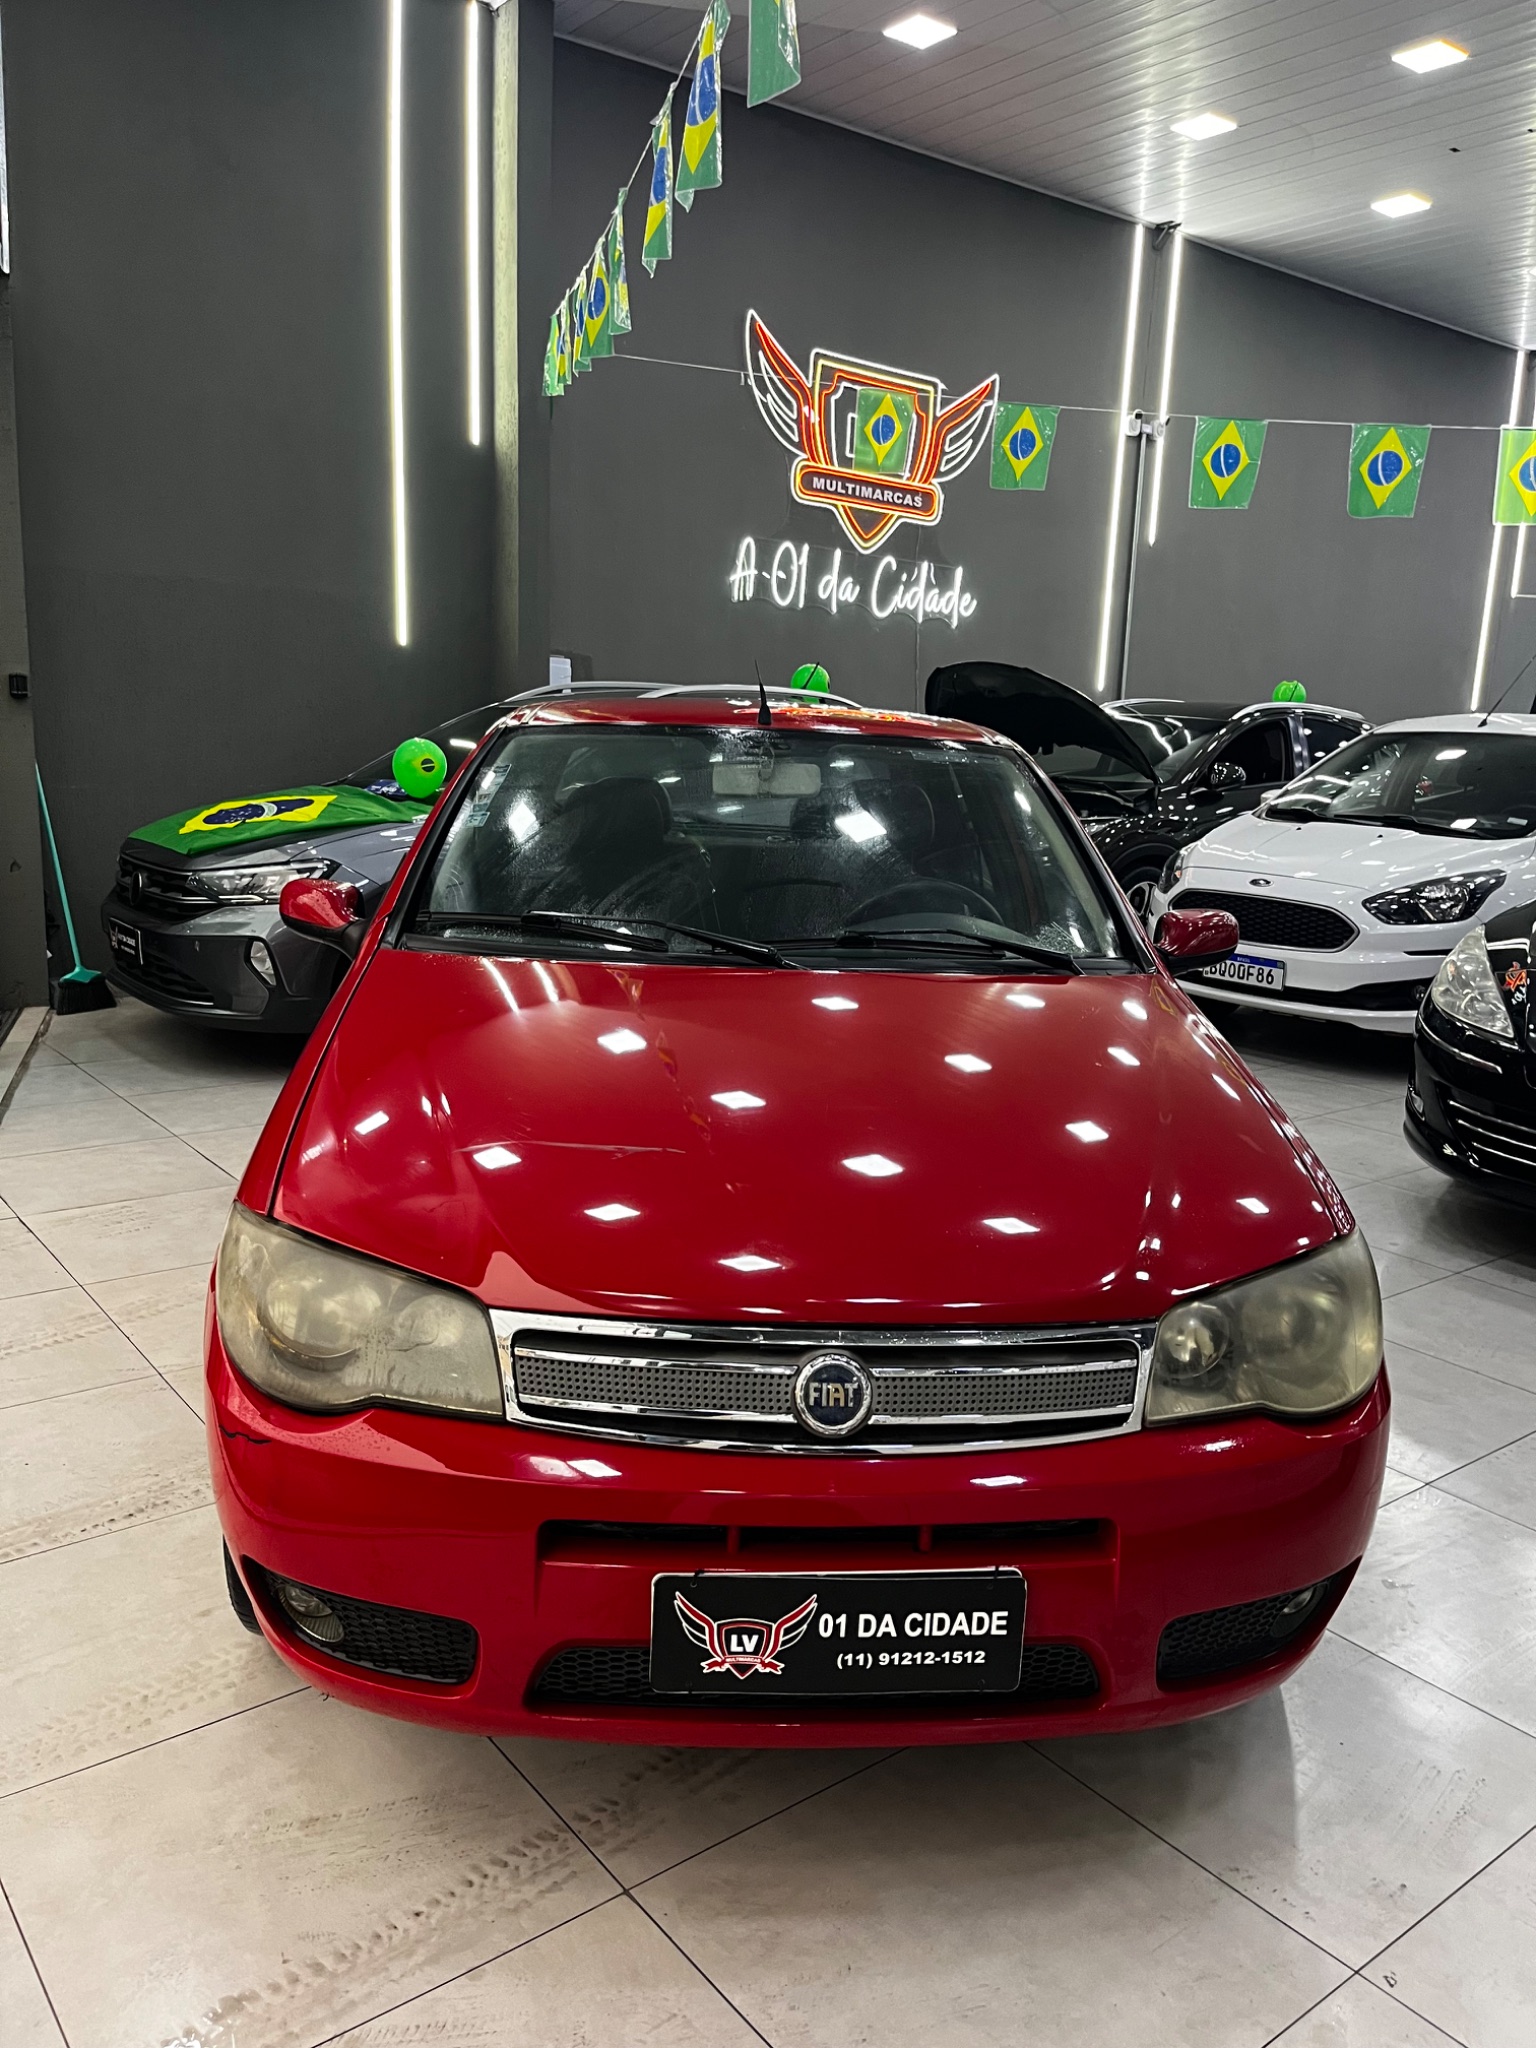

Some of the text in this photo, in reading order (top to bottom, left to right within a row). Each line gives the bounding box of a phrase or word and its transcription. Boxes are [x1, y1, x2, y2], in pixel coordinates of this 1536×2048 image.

[812, 477, 923, 507] MULTIMARCAS
[818, 548, 860, 614] da
[808, 1382, 859, 1407] FIAT
[818, 1611, 1009, 1638] 01 DA CIDADE
[730, 1634, 759, 1652] LV
[836, 1651, 986, 1669] (11) 91212-1512
